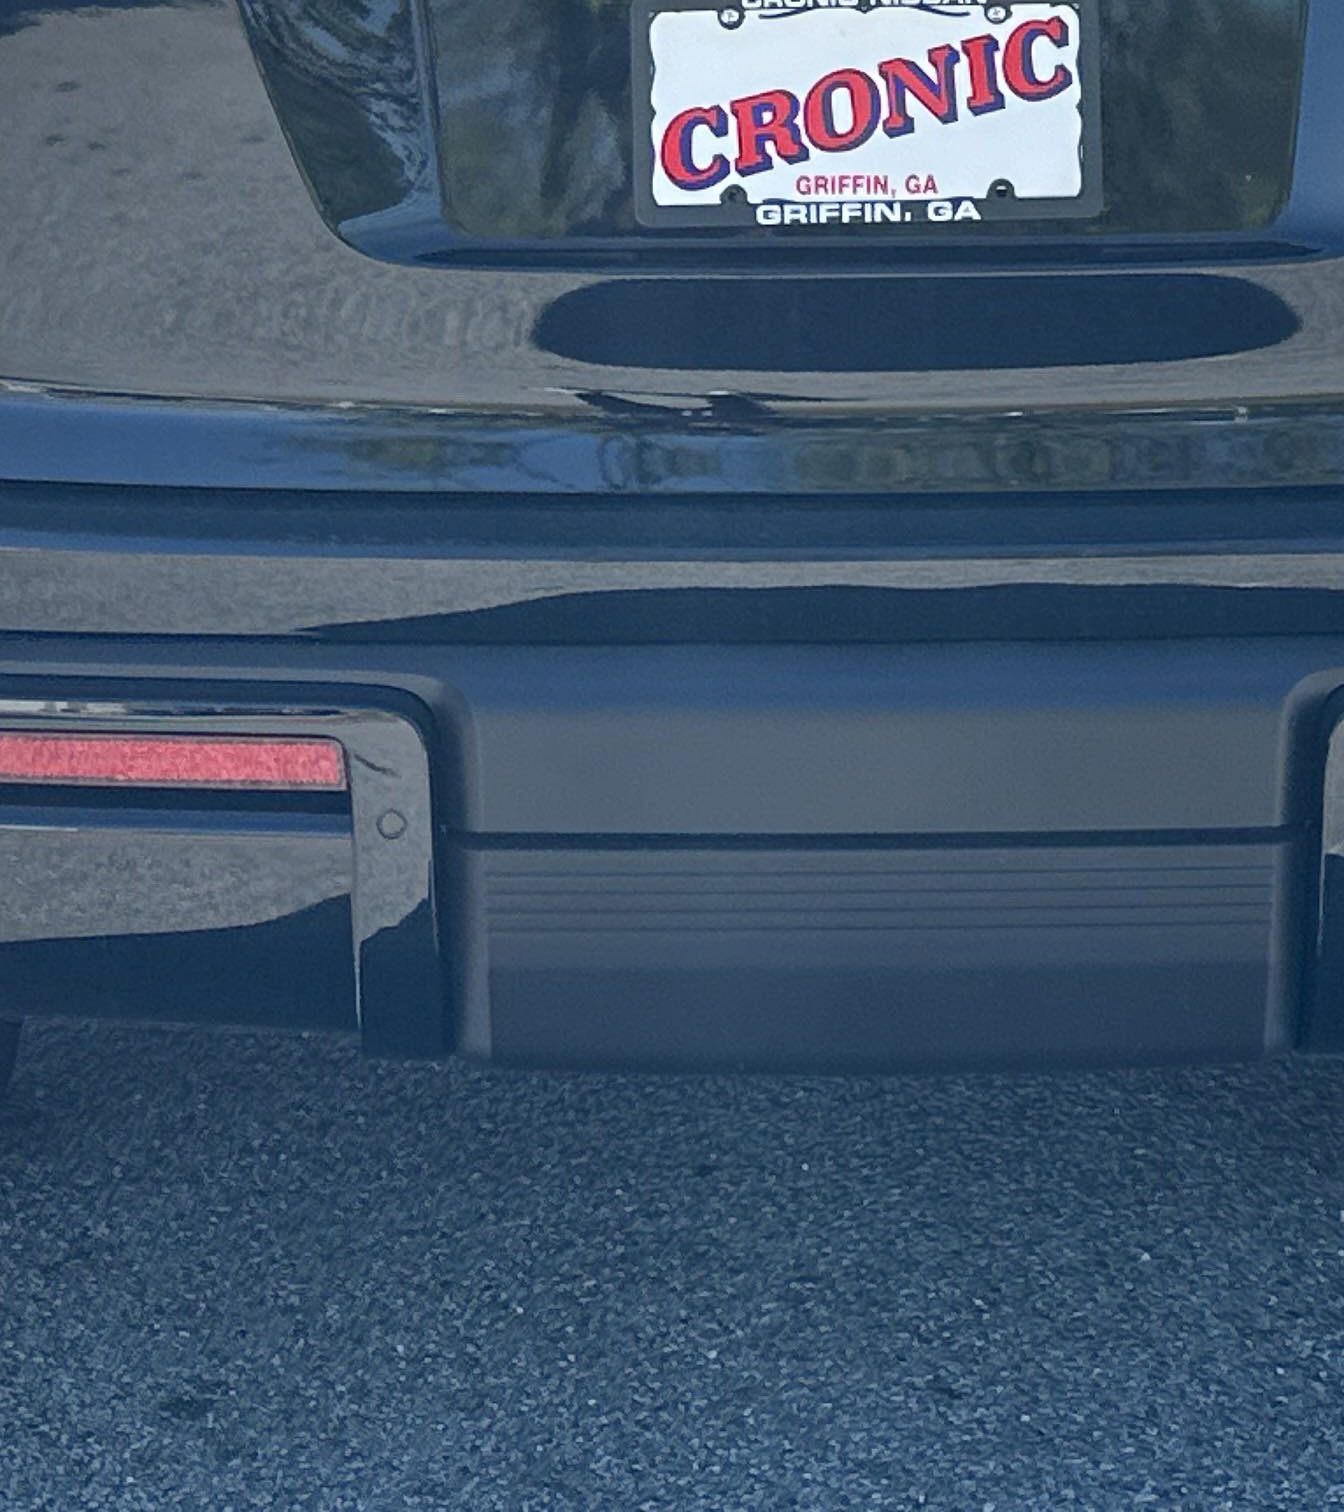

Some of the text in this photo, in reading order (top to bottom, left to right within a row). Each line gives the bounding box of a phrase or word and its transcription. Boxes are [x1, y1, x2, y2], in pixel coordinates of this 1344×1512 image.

[660, 16, 1073, 191] CRONIC
[795, 174, 939, 199] GRIFFIN, GA
[927, 199, 982, 223] GA
